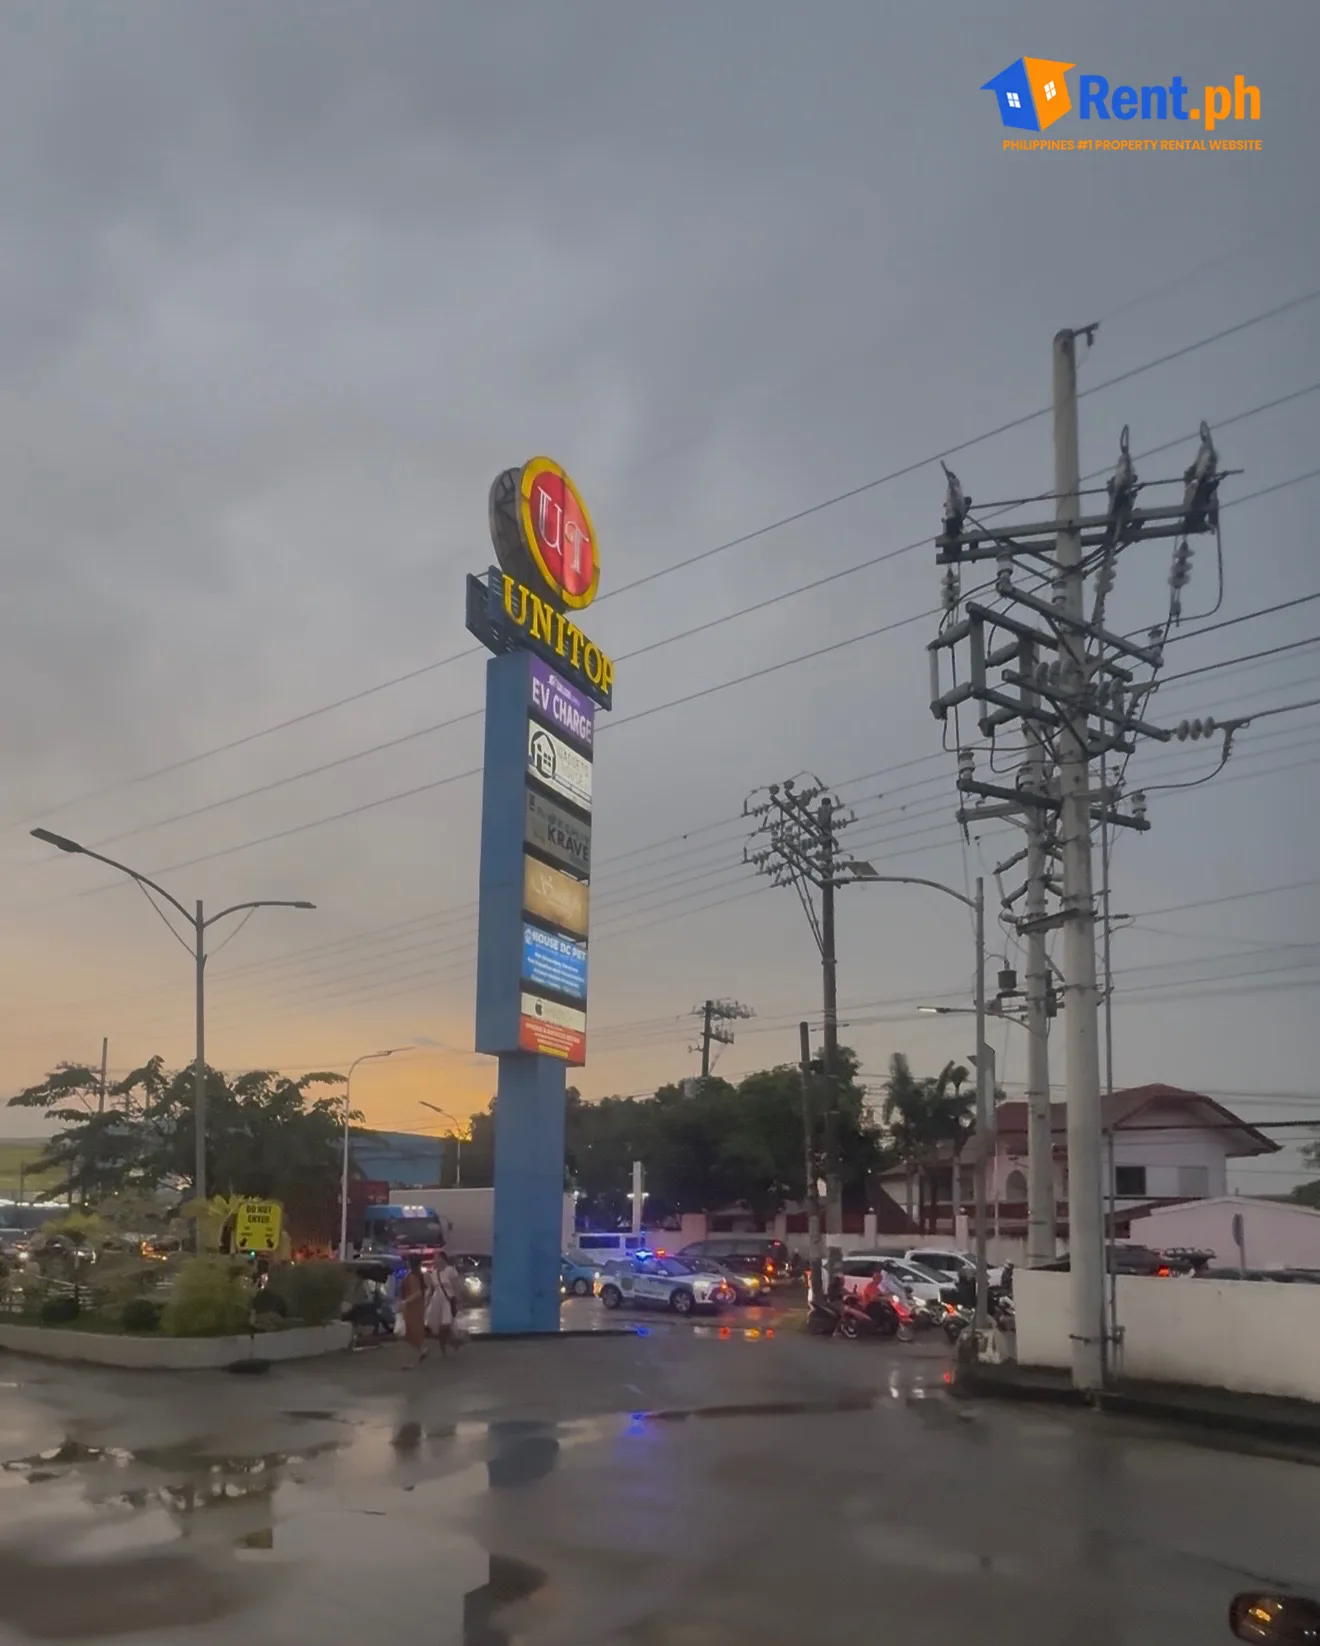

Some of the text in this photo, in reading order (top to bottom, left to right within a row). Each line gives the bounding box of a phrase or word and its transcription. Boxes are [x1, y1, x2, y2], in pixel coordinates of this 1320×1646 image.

[502, 573, 616, 695] UNITOP
[532, 676, 550, 711] EV
[552, 694, 592, 744] CHARGE
[548, 823, 589, 861] KRAVE
[532, 930, 559, 951] HOUSE
[246, 1205, 272, 1214] DO NOT
